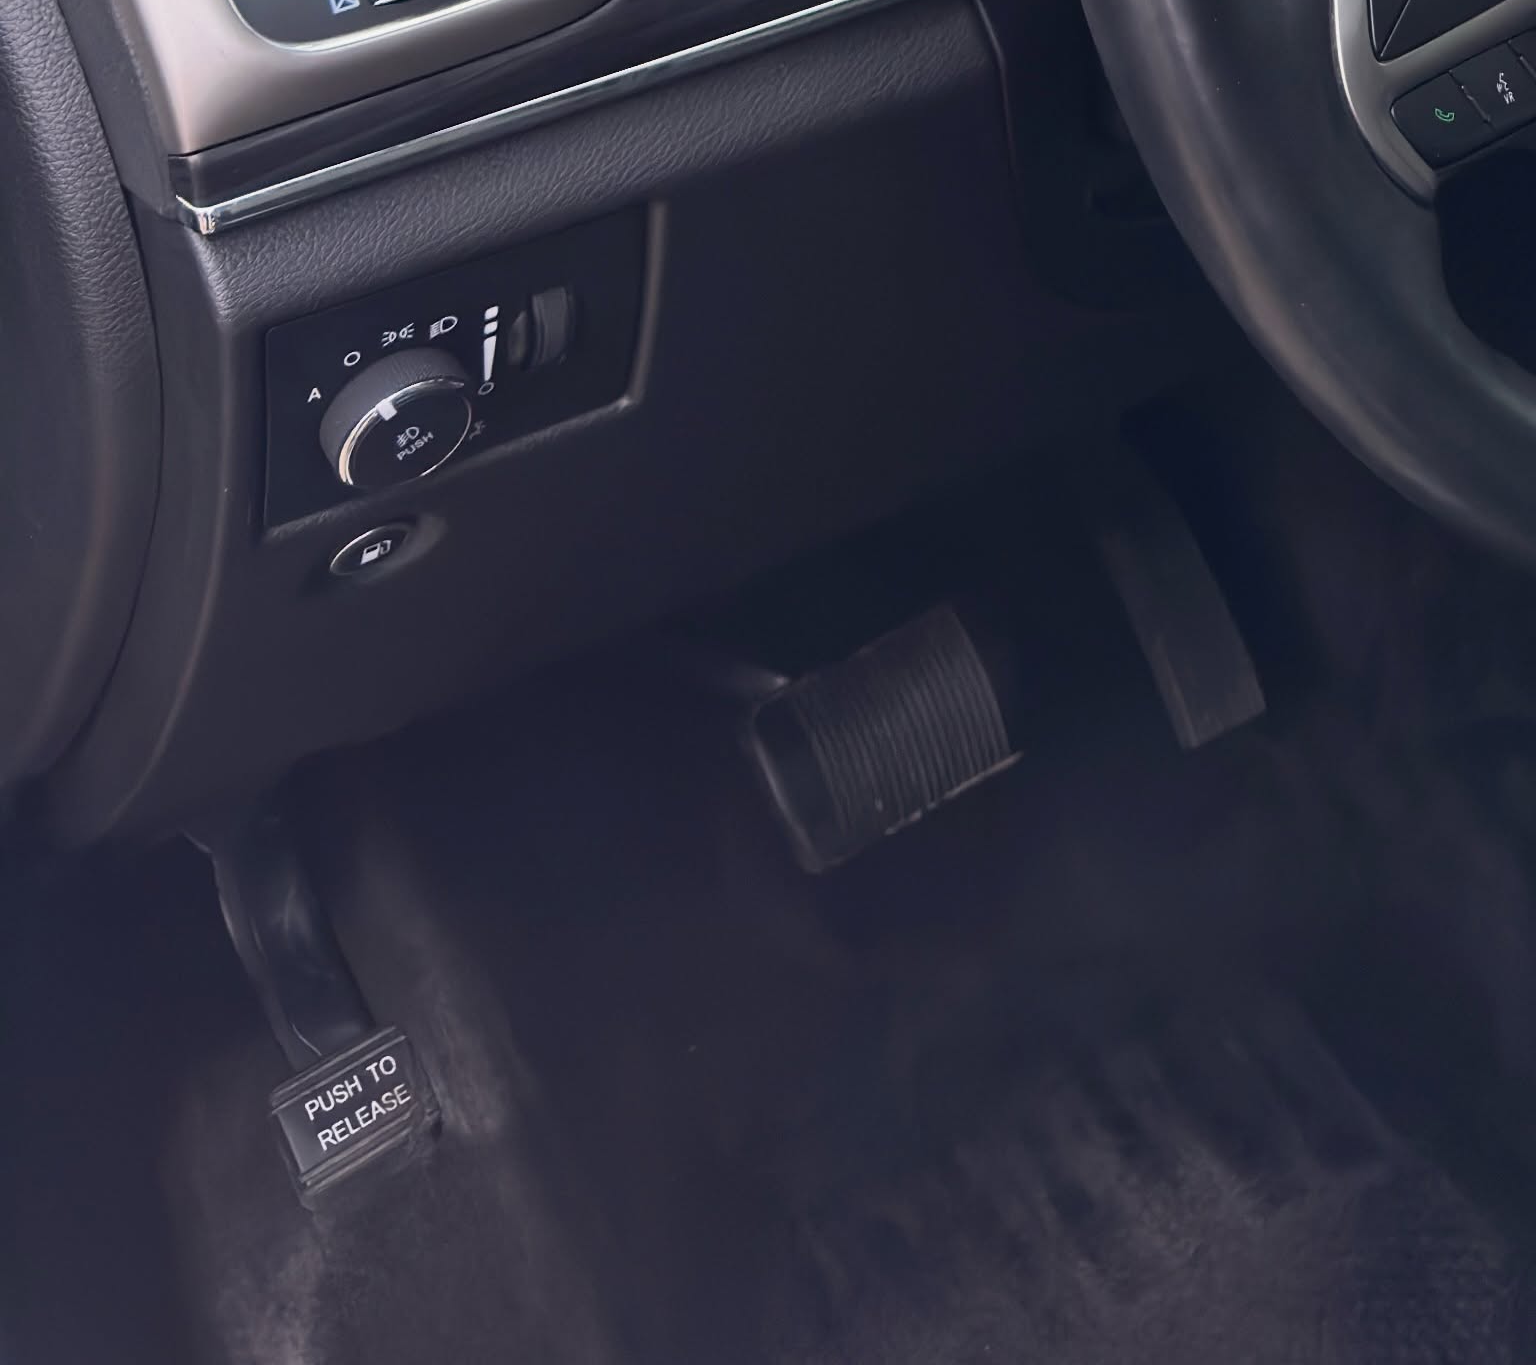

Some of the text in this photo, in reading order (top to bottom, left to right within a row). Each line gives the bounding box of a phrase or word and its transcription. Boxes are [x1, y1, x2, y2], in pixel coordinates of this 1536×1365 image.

[1503, 91, 1516, 105] VR
[307, 387, 322, 403] A
[396, 431, 434, 461] PUSH
[304, 1055, 397, 1121] PUSH TO
[317, 1083, 412, 1151] RELEASE
